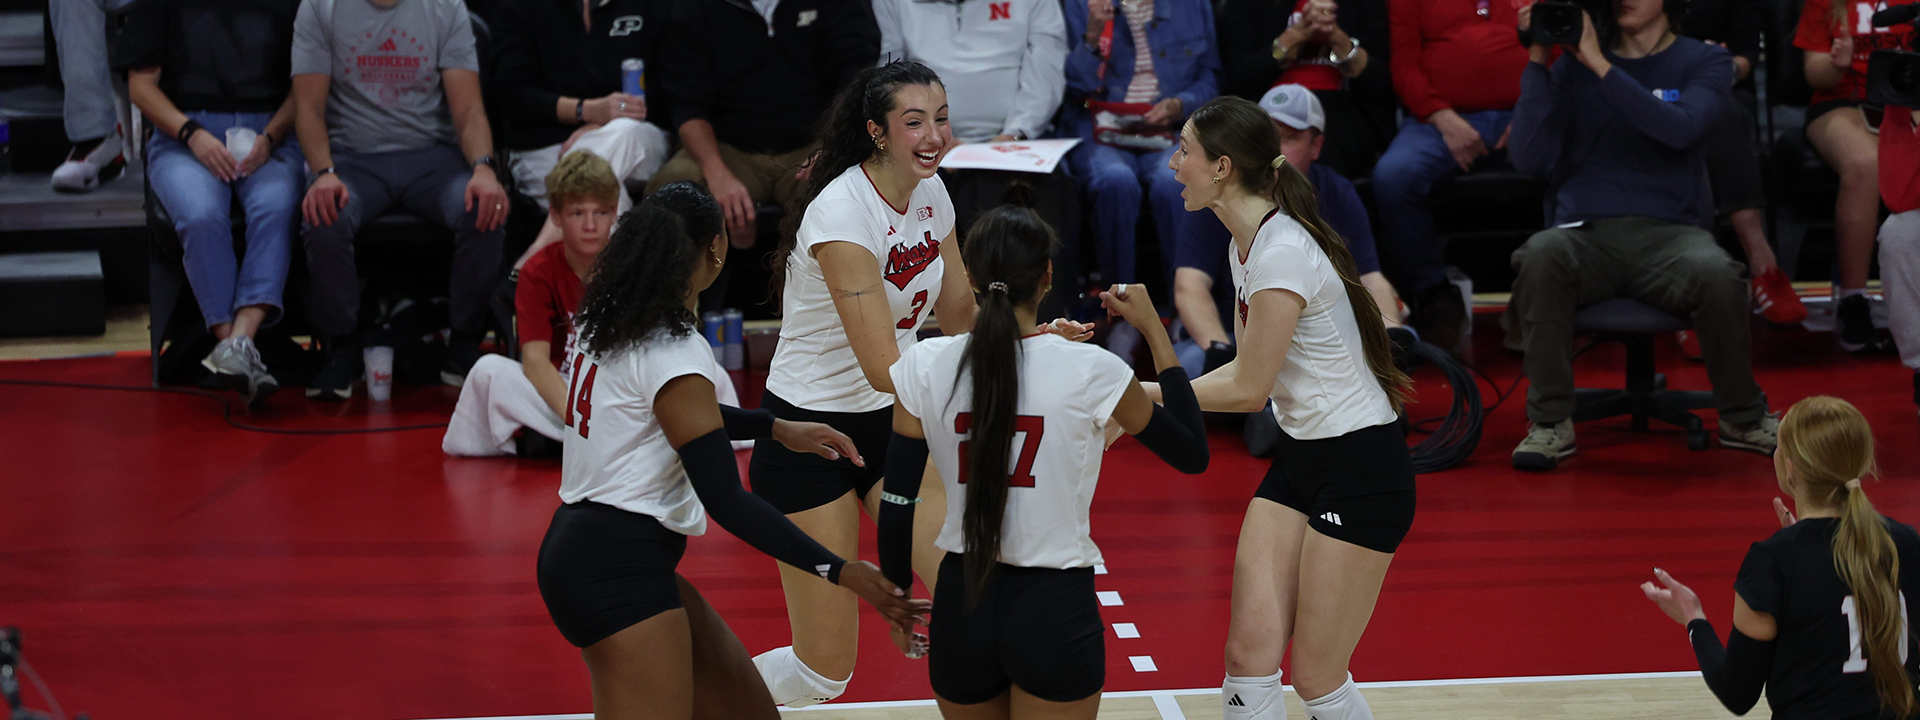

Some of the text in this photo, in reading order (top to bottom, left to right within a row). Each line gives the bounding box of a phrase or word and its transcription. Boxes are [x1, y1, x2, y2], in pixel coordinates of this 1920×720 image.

[608, 15, 644, 37] P
[988, 1, 1012, 21] N
[357, 54, 421, 69] HUSKERS
[896, 289, 928, 330] 3
[565, 351, 599, 440] 14
[1841, 588, 1909, 674] 1
